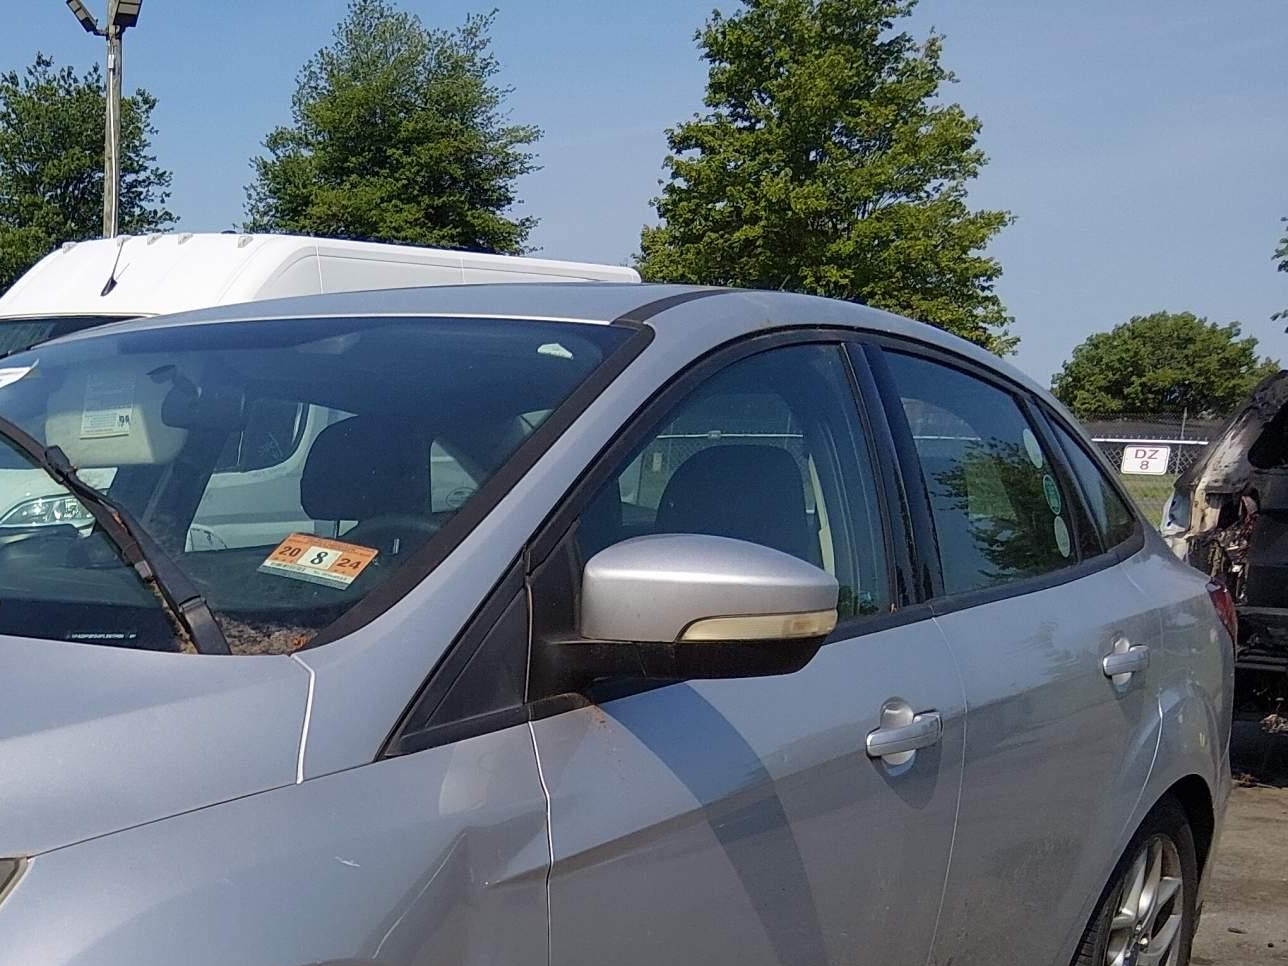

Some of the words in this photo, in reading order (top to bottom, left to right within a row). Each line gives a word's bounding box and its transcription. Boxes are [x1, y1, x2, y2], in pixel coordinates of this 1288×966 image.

[1134, 449, 1160, 460] DZ
[1139, 461, 1149, 471] 8
[279, 545, 301, 558] 20
[310, 551, 329, 566] 8
[336, 557, 361, 571] 24
